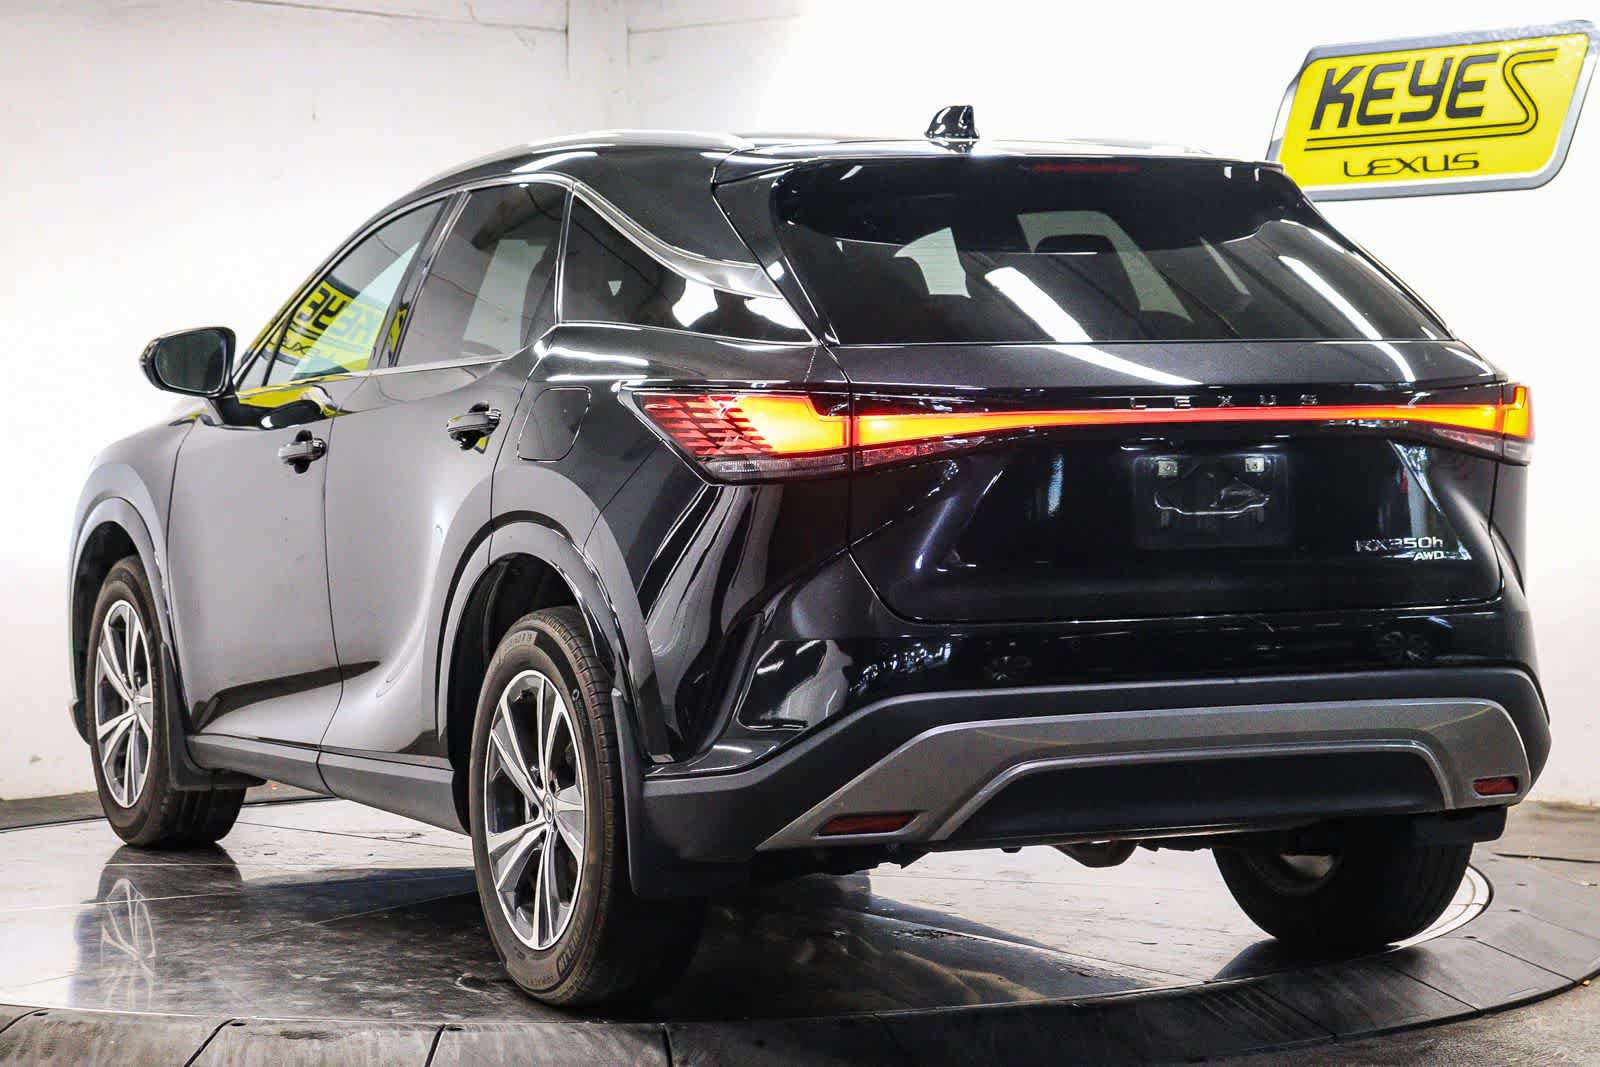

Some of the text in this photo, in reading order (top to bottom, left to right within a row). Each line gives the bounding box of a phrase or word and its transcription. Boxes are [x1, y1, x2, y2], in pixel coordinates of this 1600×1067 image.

[1309, 47, 1559, 131] KEYES
[1343, 152, 1480, 178] LEXUS
[1129, 394, 1318, 409] LEXUS
[1413, 550, 1446, 561] AWD
